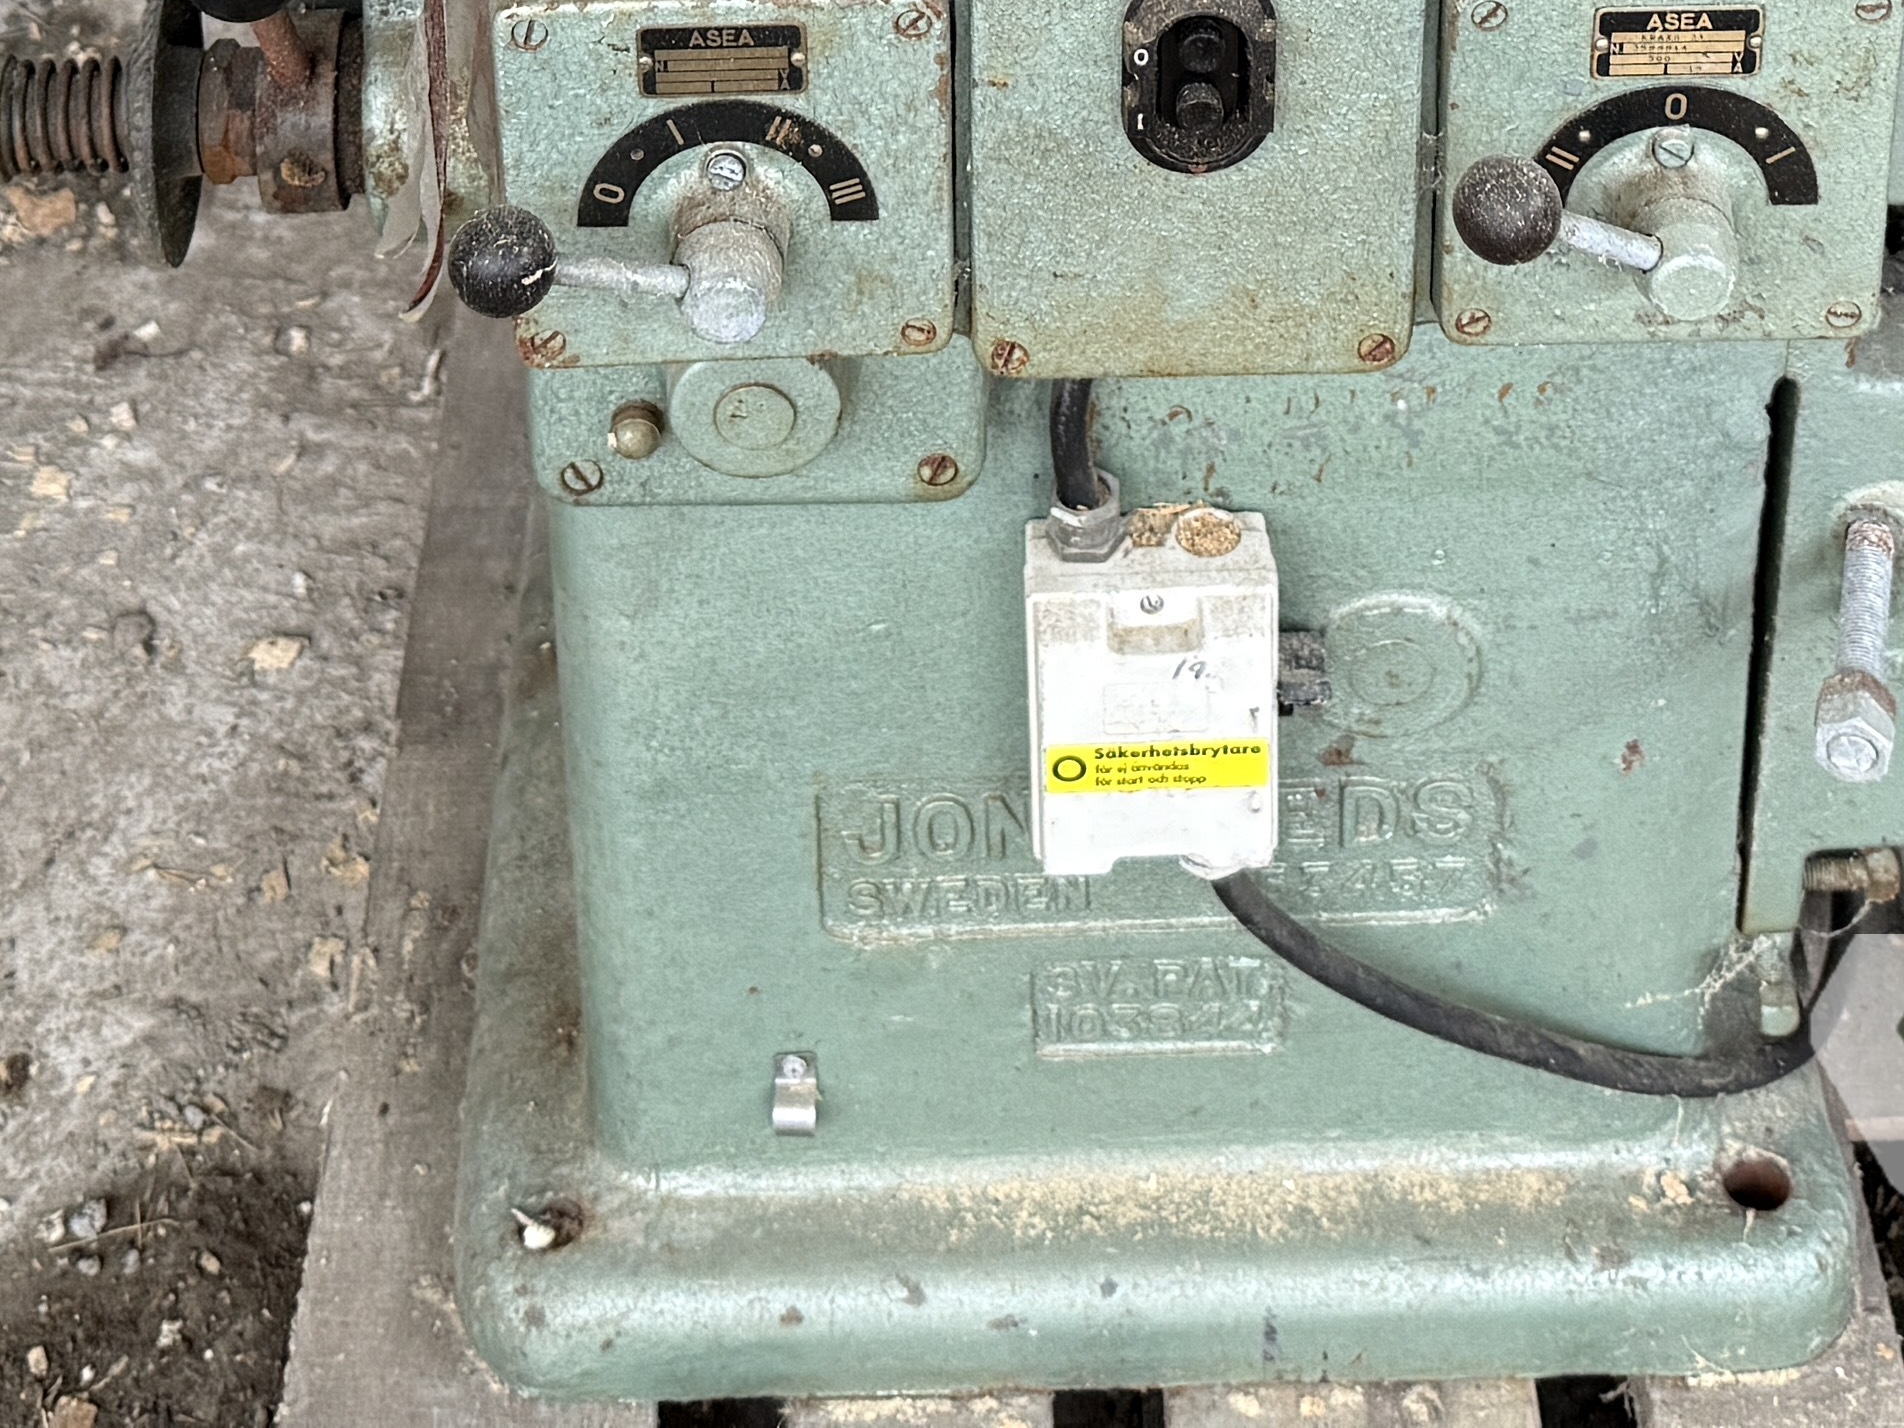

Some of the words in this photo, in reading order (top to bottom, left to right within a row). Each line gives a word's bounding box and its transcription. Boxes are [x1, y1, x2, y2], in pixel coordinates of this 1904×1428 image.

[1646, 12, 1714, 31] ASEA
[689, 28, 756, 48] ASEA
[1094, 743, 1262, 761] Säkerhetsbrytare
[1116, 775, 1144, 786] start
[1147, 773, 1169, 784] och
[1172, 774, 1207, 785] stopp
[848, 874, 1093, 916] SWEDEN
